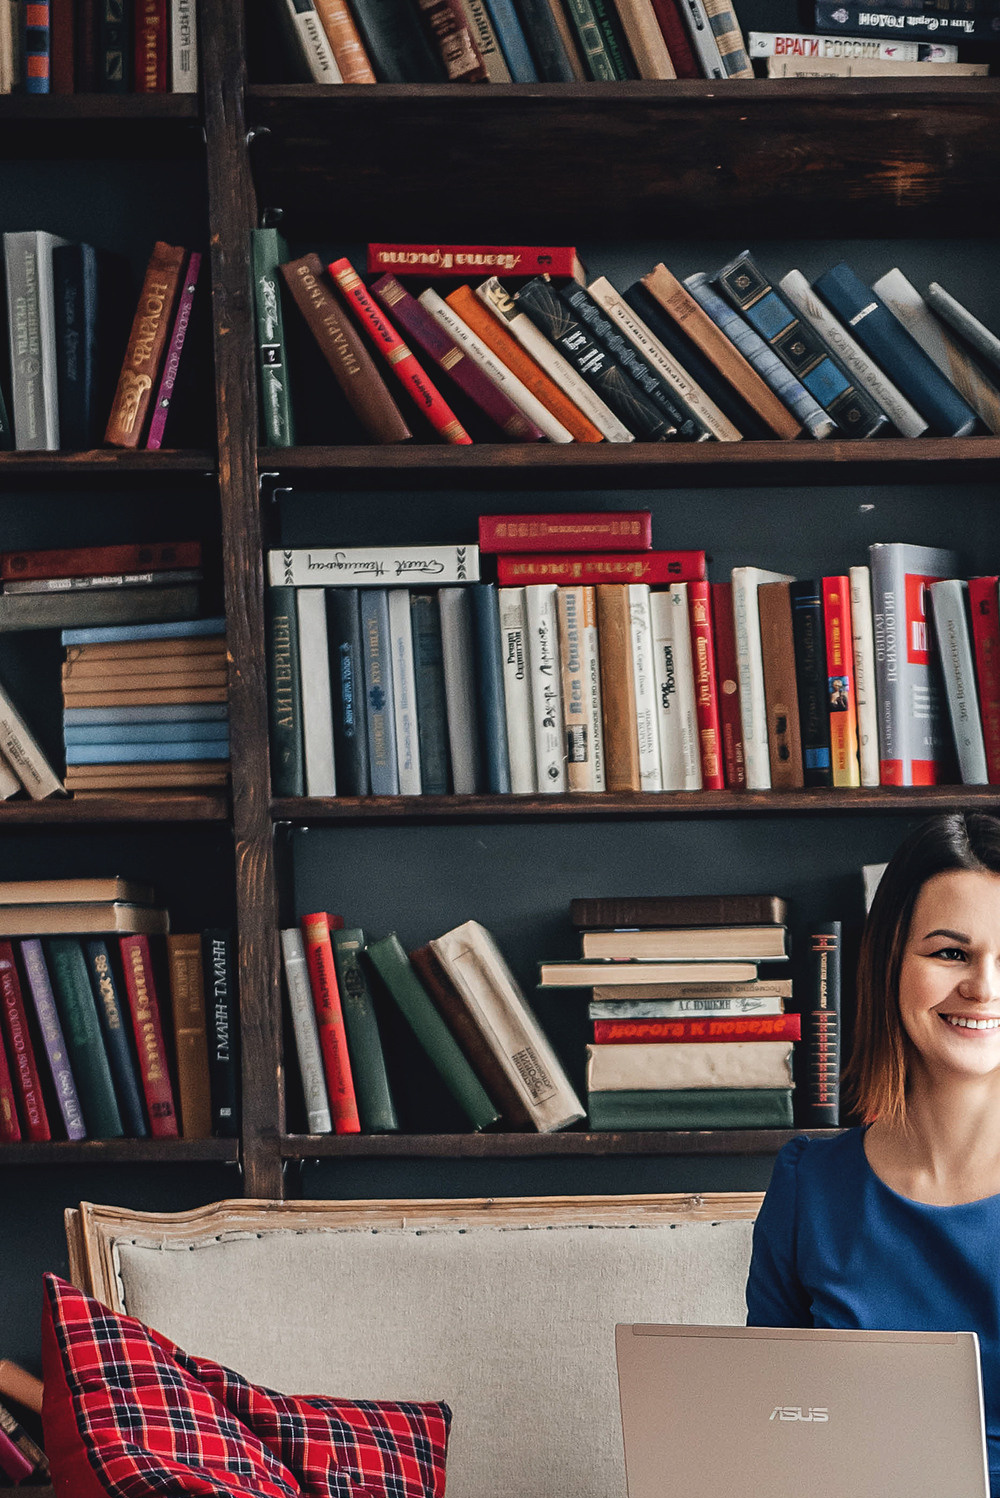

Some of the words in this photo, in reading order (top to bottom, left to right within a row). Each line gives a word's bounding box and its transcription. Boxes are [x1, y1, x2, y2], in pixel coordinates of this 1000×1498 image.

[774, 37, 819, 58] ВРАГИ
[823, 39, 880, 61] РОССИИ
[295, 264, 328, 309] ХЬЮЗ
[131, 280, 168, 368] ФАРАОН
[321, 313, 362, 374] РИЧАРД
[306, 550, 390, 576] Hemingway
[393, 559, 444, 574] Ernest
[505, 632, 516, 664] Ричард
[693, 635, 710, 681] Буссенар
[873, 612, 887, 661] ОБЩАЯ
[880, 590, 901, 682] ПСИХОЛОГИЯ
[664, 645, 675, 694] ПОЛЕВОЙ
[769, 1406, 829, 1423] ASUS
